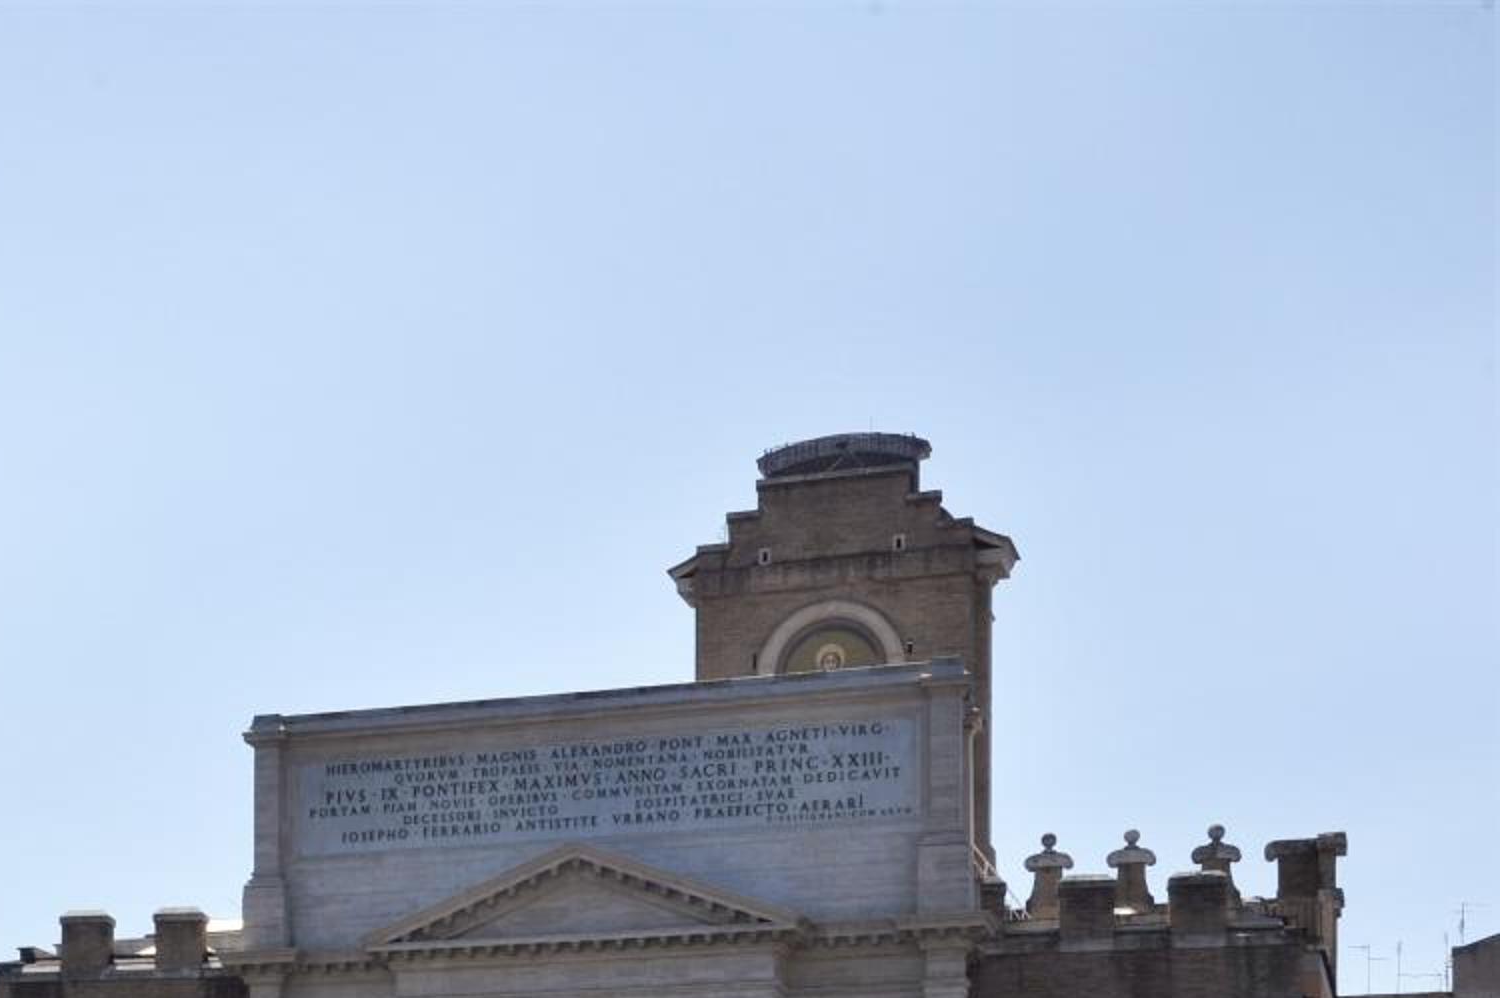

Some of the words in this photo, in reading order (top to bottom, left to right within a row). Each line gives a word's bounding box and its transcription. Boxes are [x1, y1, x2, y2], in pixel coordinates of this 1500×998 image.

[551, 741, 646, 759] ALEXANDRO
[660, 736, 701, 751] PONT
[717, 733, 751, 746] MAX
[767, 726, 827, 742] AGNETI
[326, 788, 366, 805] PIVS
[381, 787, 398, 801] IX
[413, 781, 499, 798] PONTIFEX
[514, 771, 601, 791] MAXIMVS
[615, 767, 666, 784] ANNO
[679, 762, 736, 779] SACRI
[754, 756, 819, 774] PRINC
[804, 766, 900, 784] DEDICAVIT
